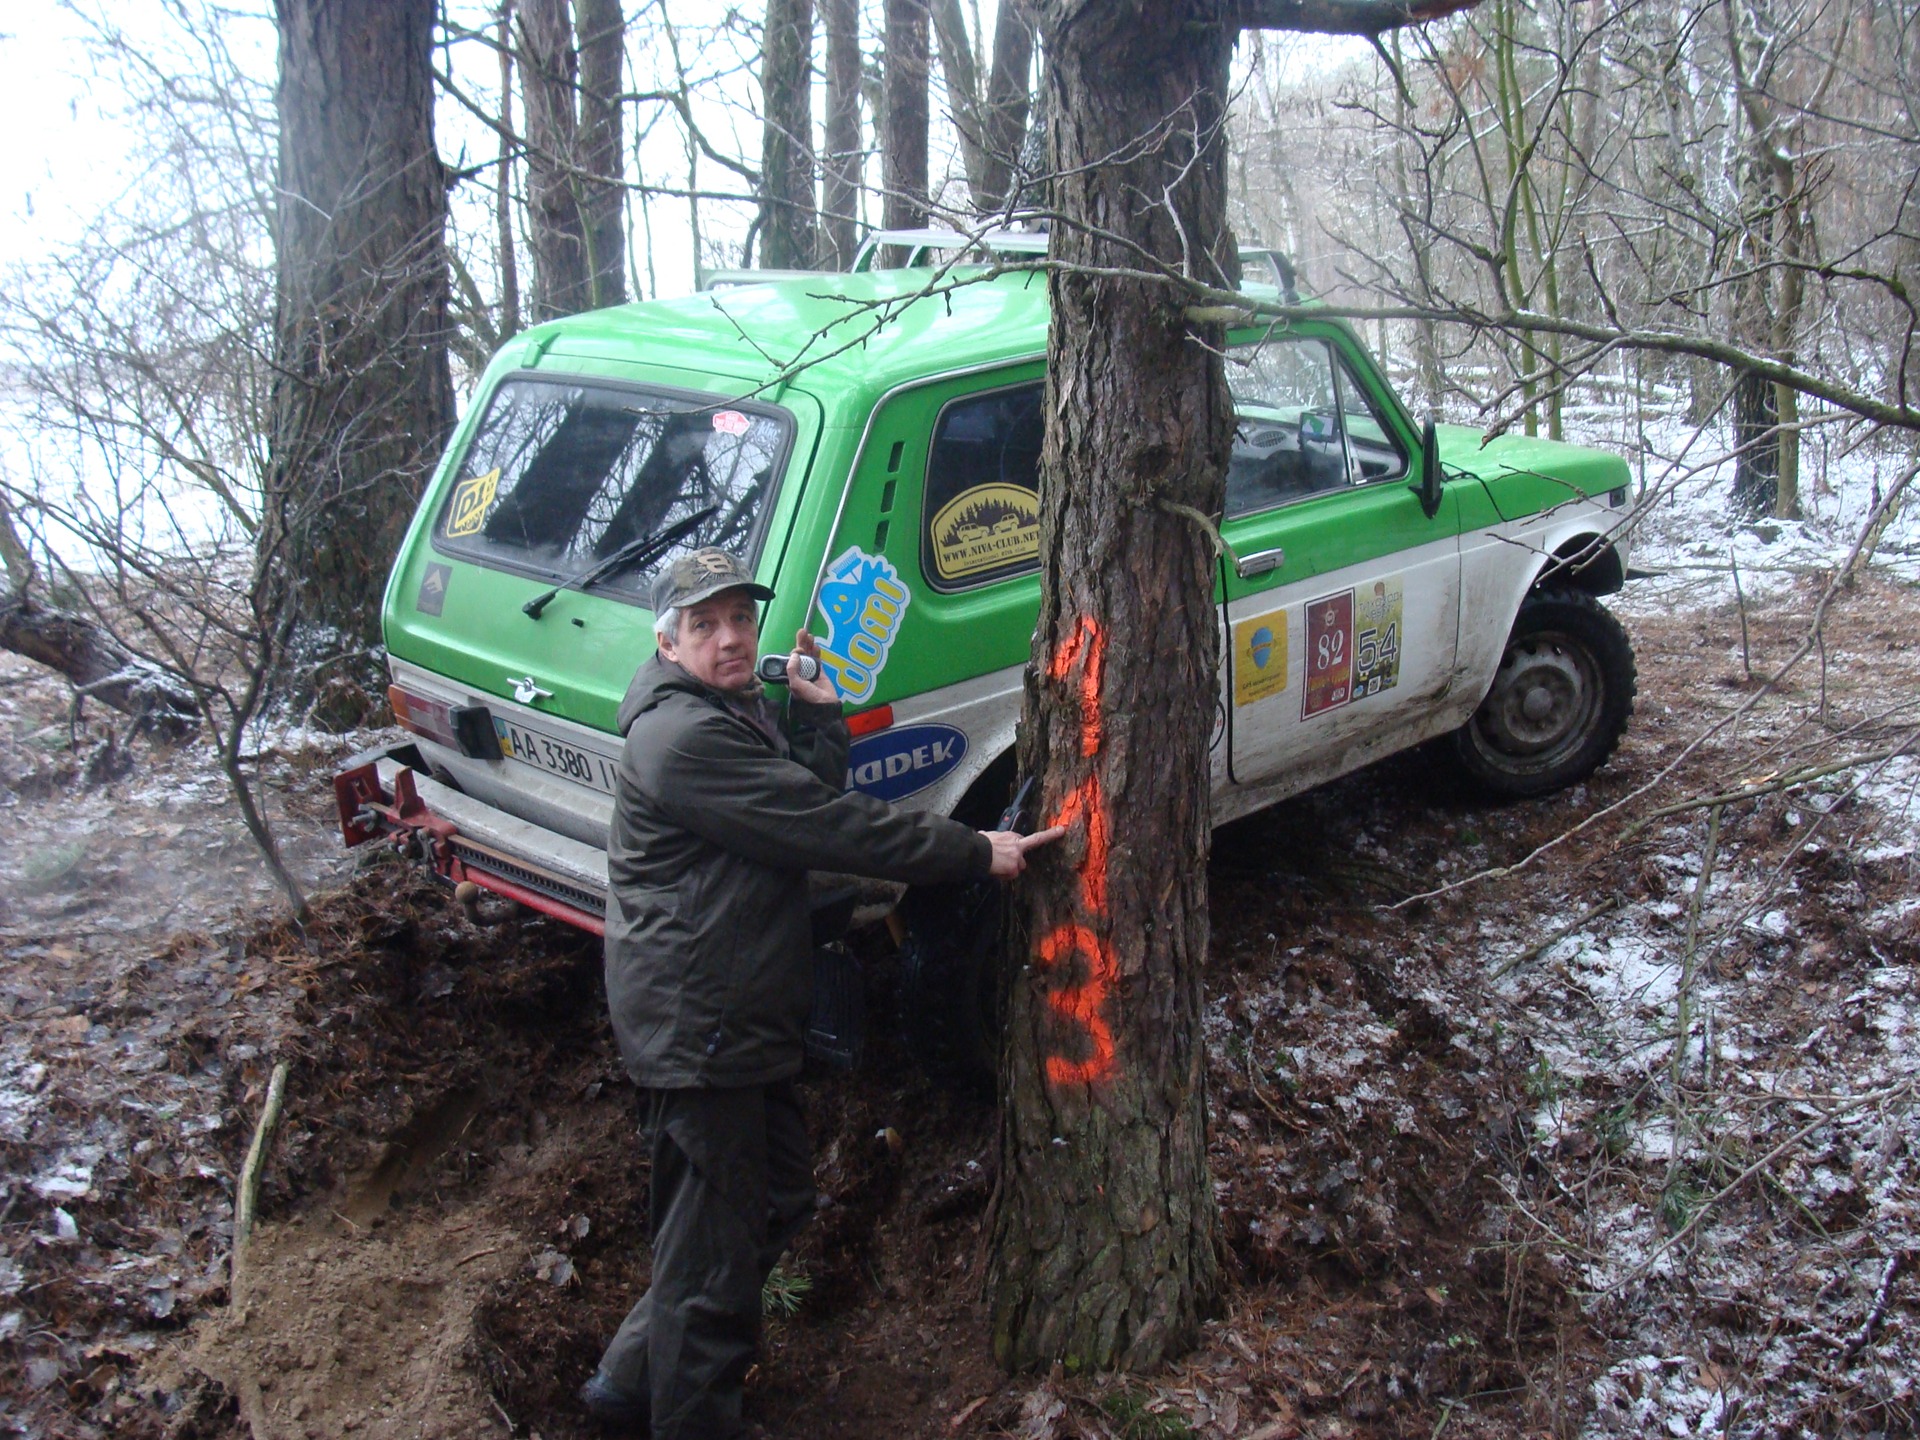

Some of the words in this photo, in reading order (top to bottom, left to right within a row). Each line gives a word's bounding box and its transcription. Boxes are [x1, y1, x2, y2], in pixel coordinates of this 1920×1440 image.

[1317, 629, 1345, 670] 82
[1357, 621, 1397, 674] 54
[510, 728, 542, 764] AA
[541, 740, 592, 782] 3380
